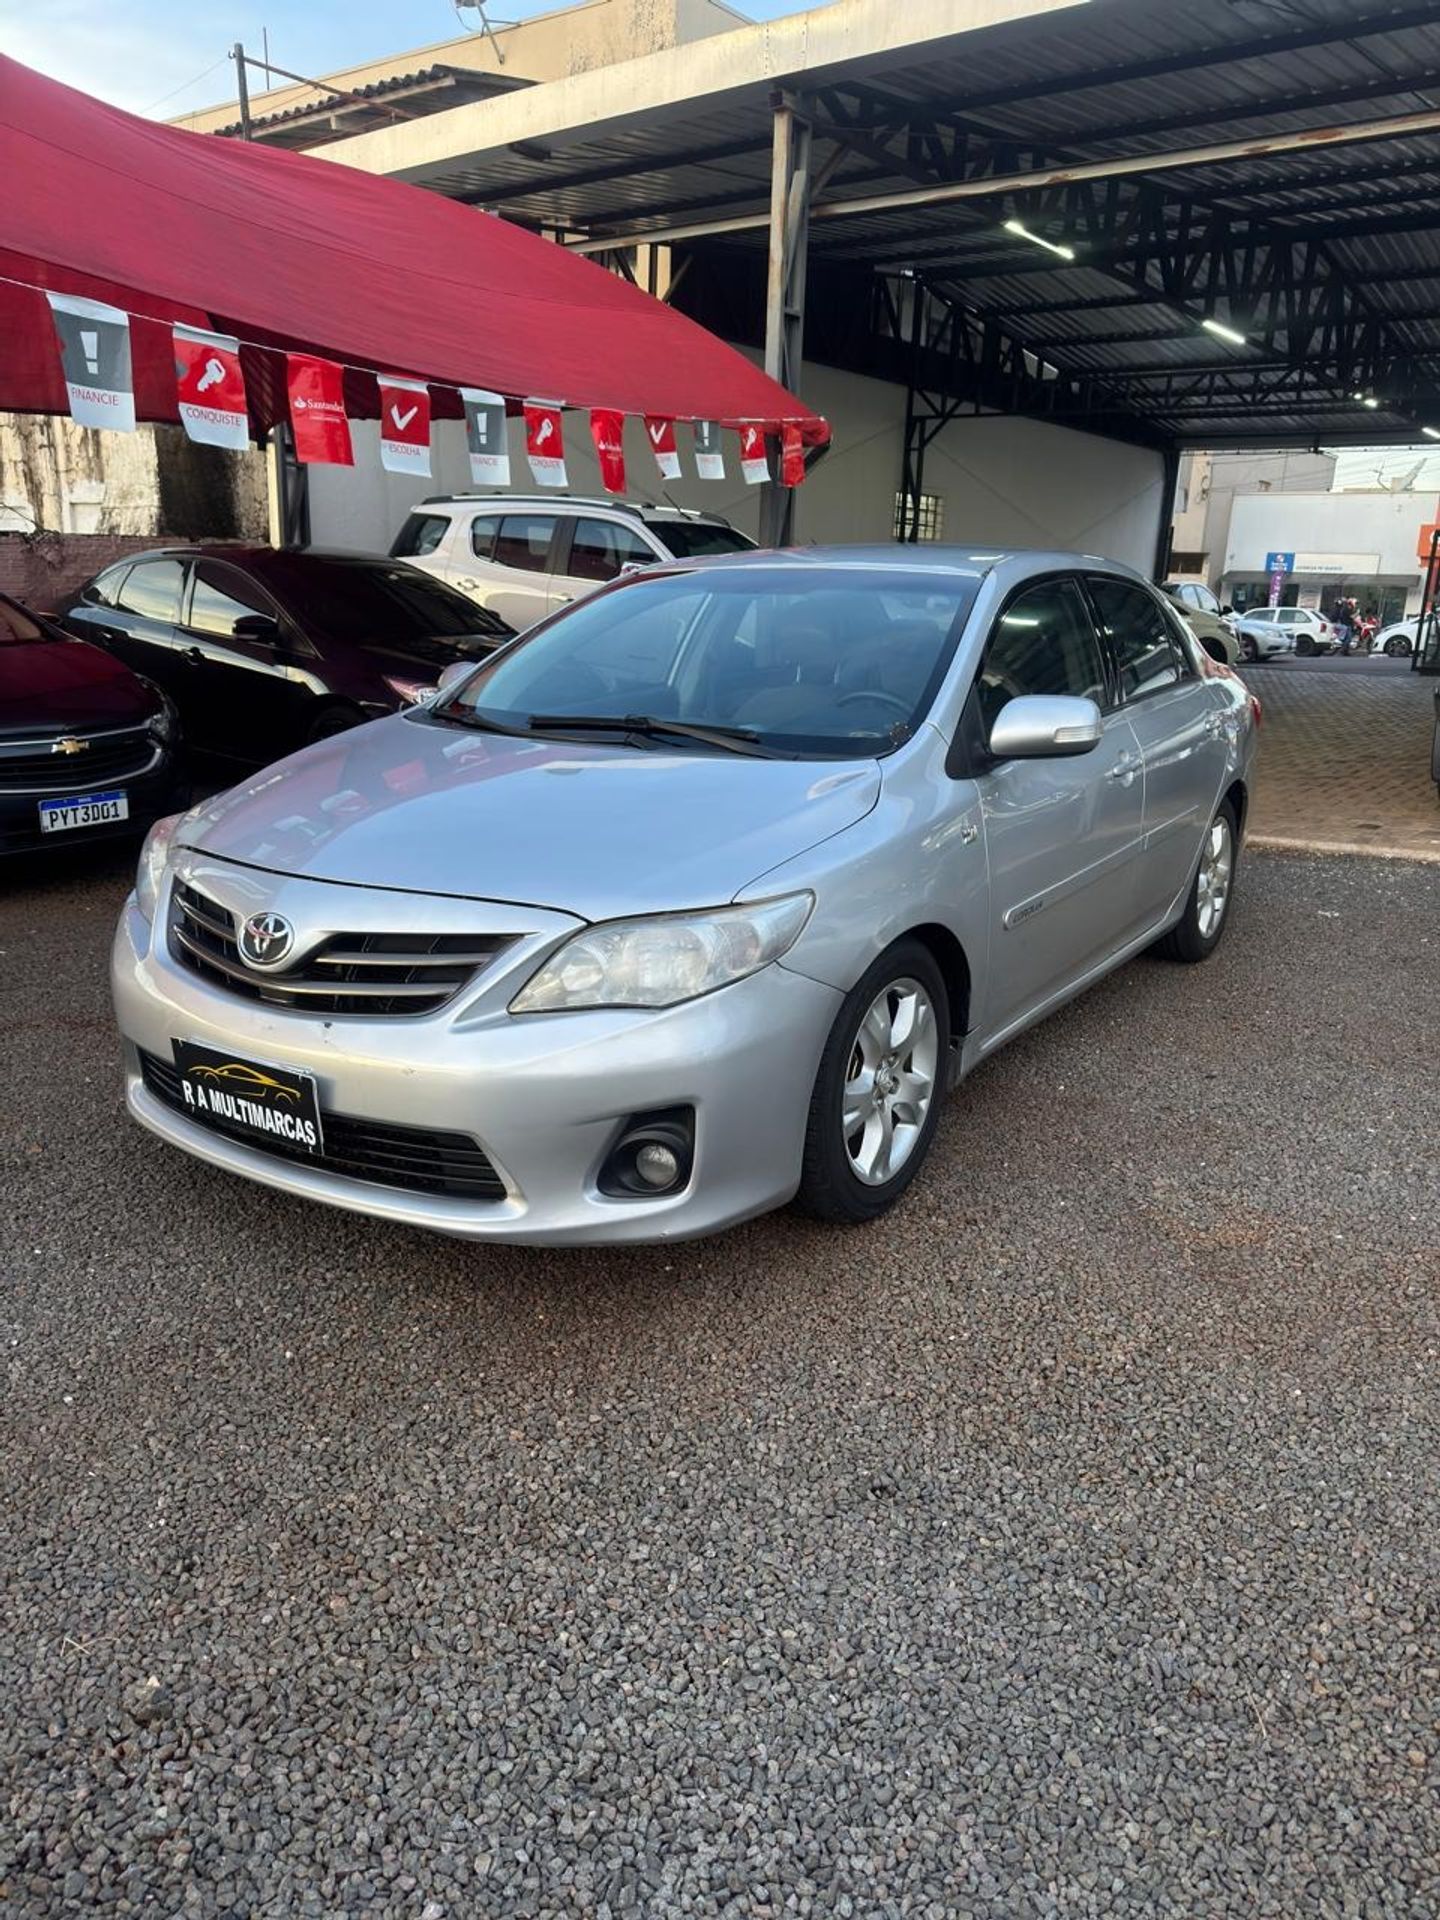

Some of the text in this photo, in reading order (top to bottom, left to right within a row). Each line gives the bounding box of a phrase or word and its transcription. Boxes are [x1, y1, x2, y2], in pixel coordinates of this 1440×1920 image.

[71, 387, 119, 406] FINANCIE
[186, 407, 242, 427] CONQUISTE
[388, 444, 421, 456] ESCOLHA
[49, 801, 120, 828] PYT3D01
[181, 1079, 317, 1146] R A MULTIMARCAS
